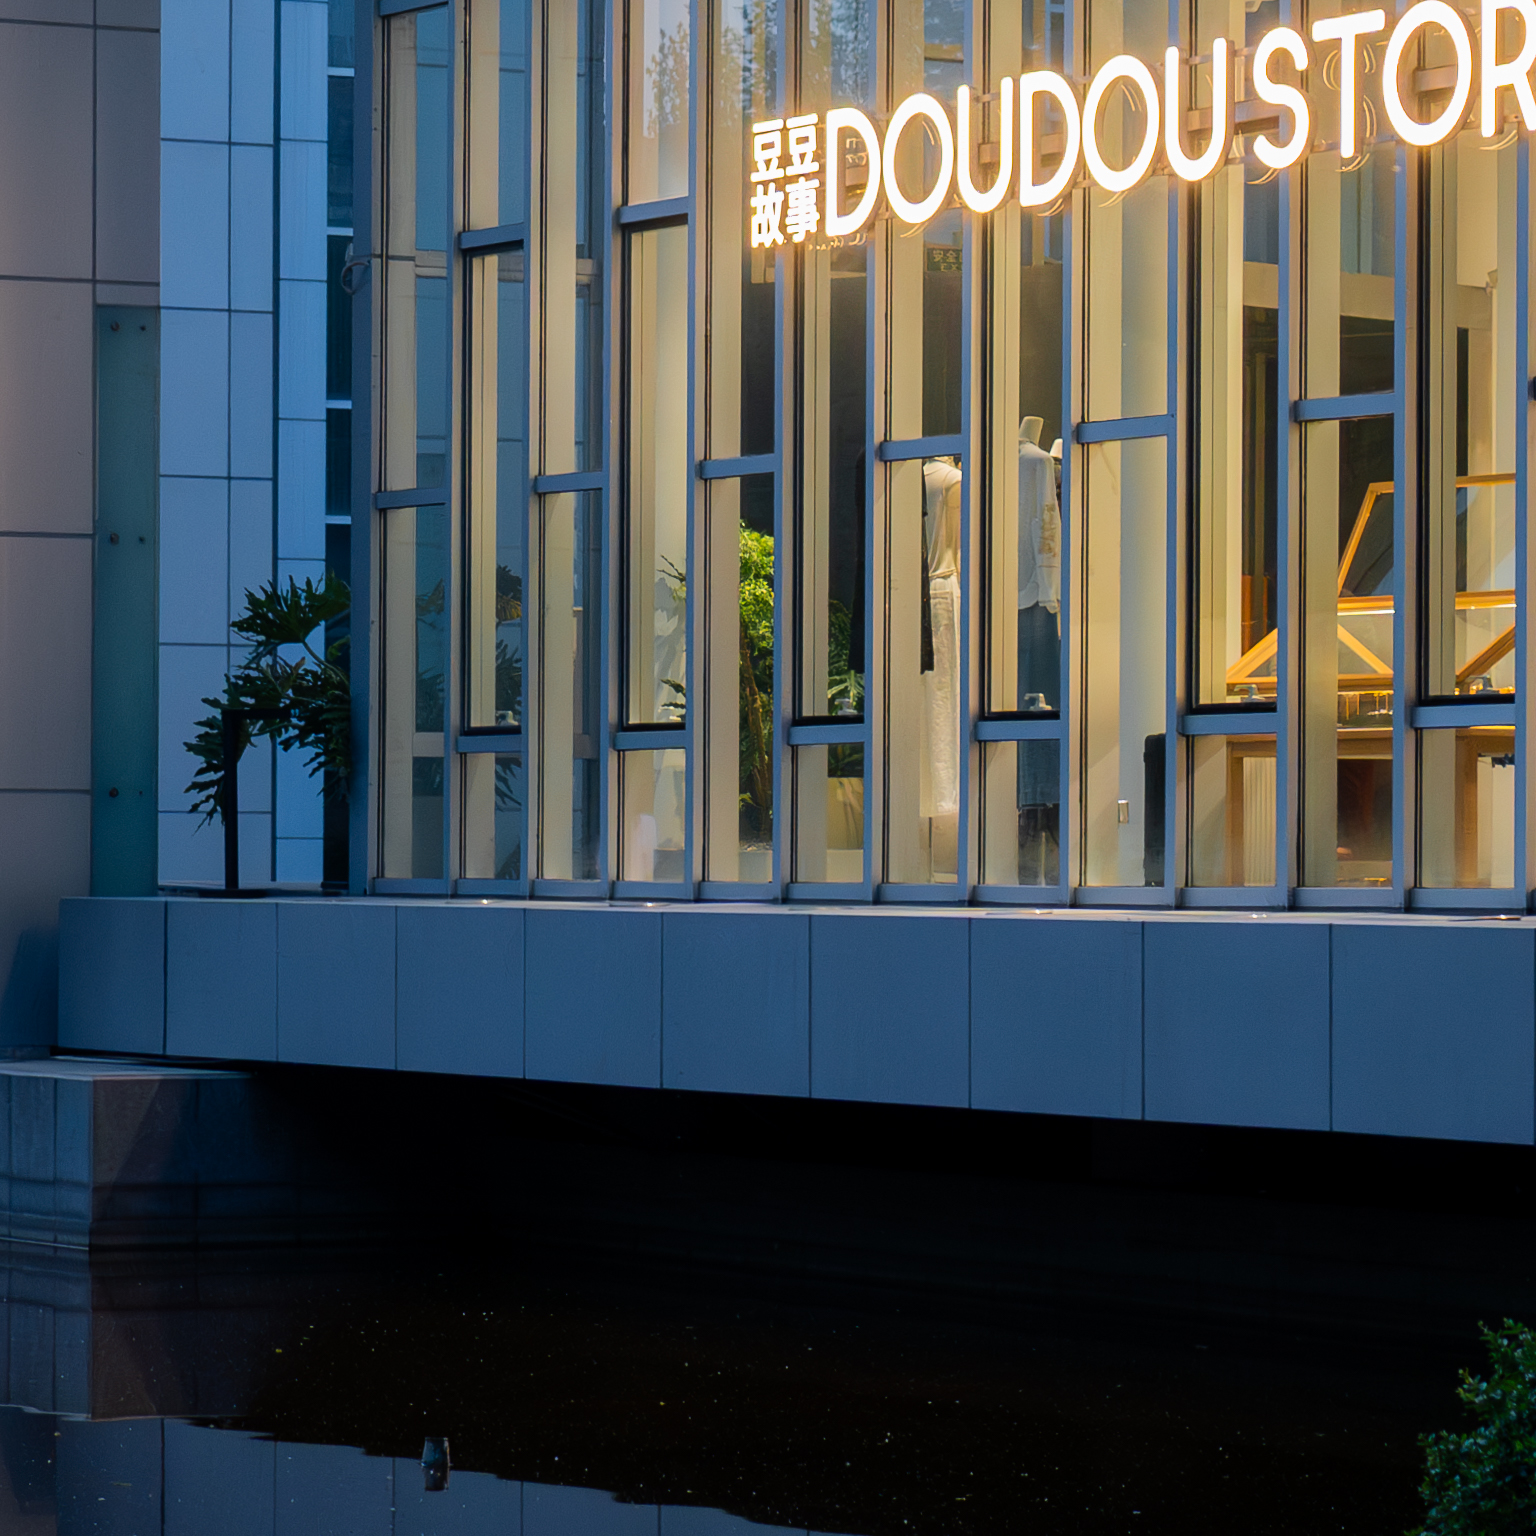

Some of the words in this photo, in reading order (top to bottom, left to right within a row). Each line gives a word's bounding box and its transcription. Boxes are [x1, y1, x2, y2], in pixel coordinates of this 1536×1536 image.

[750, 112, 820, 183] 豆豆
[825, 37, 1227, 238] DOUDOU
[750, 175, 821, 249] 故事
[933, 249, 962, 263] 安全
